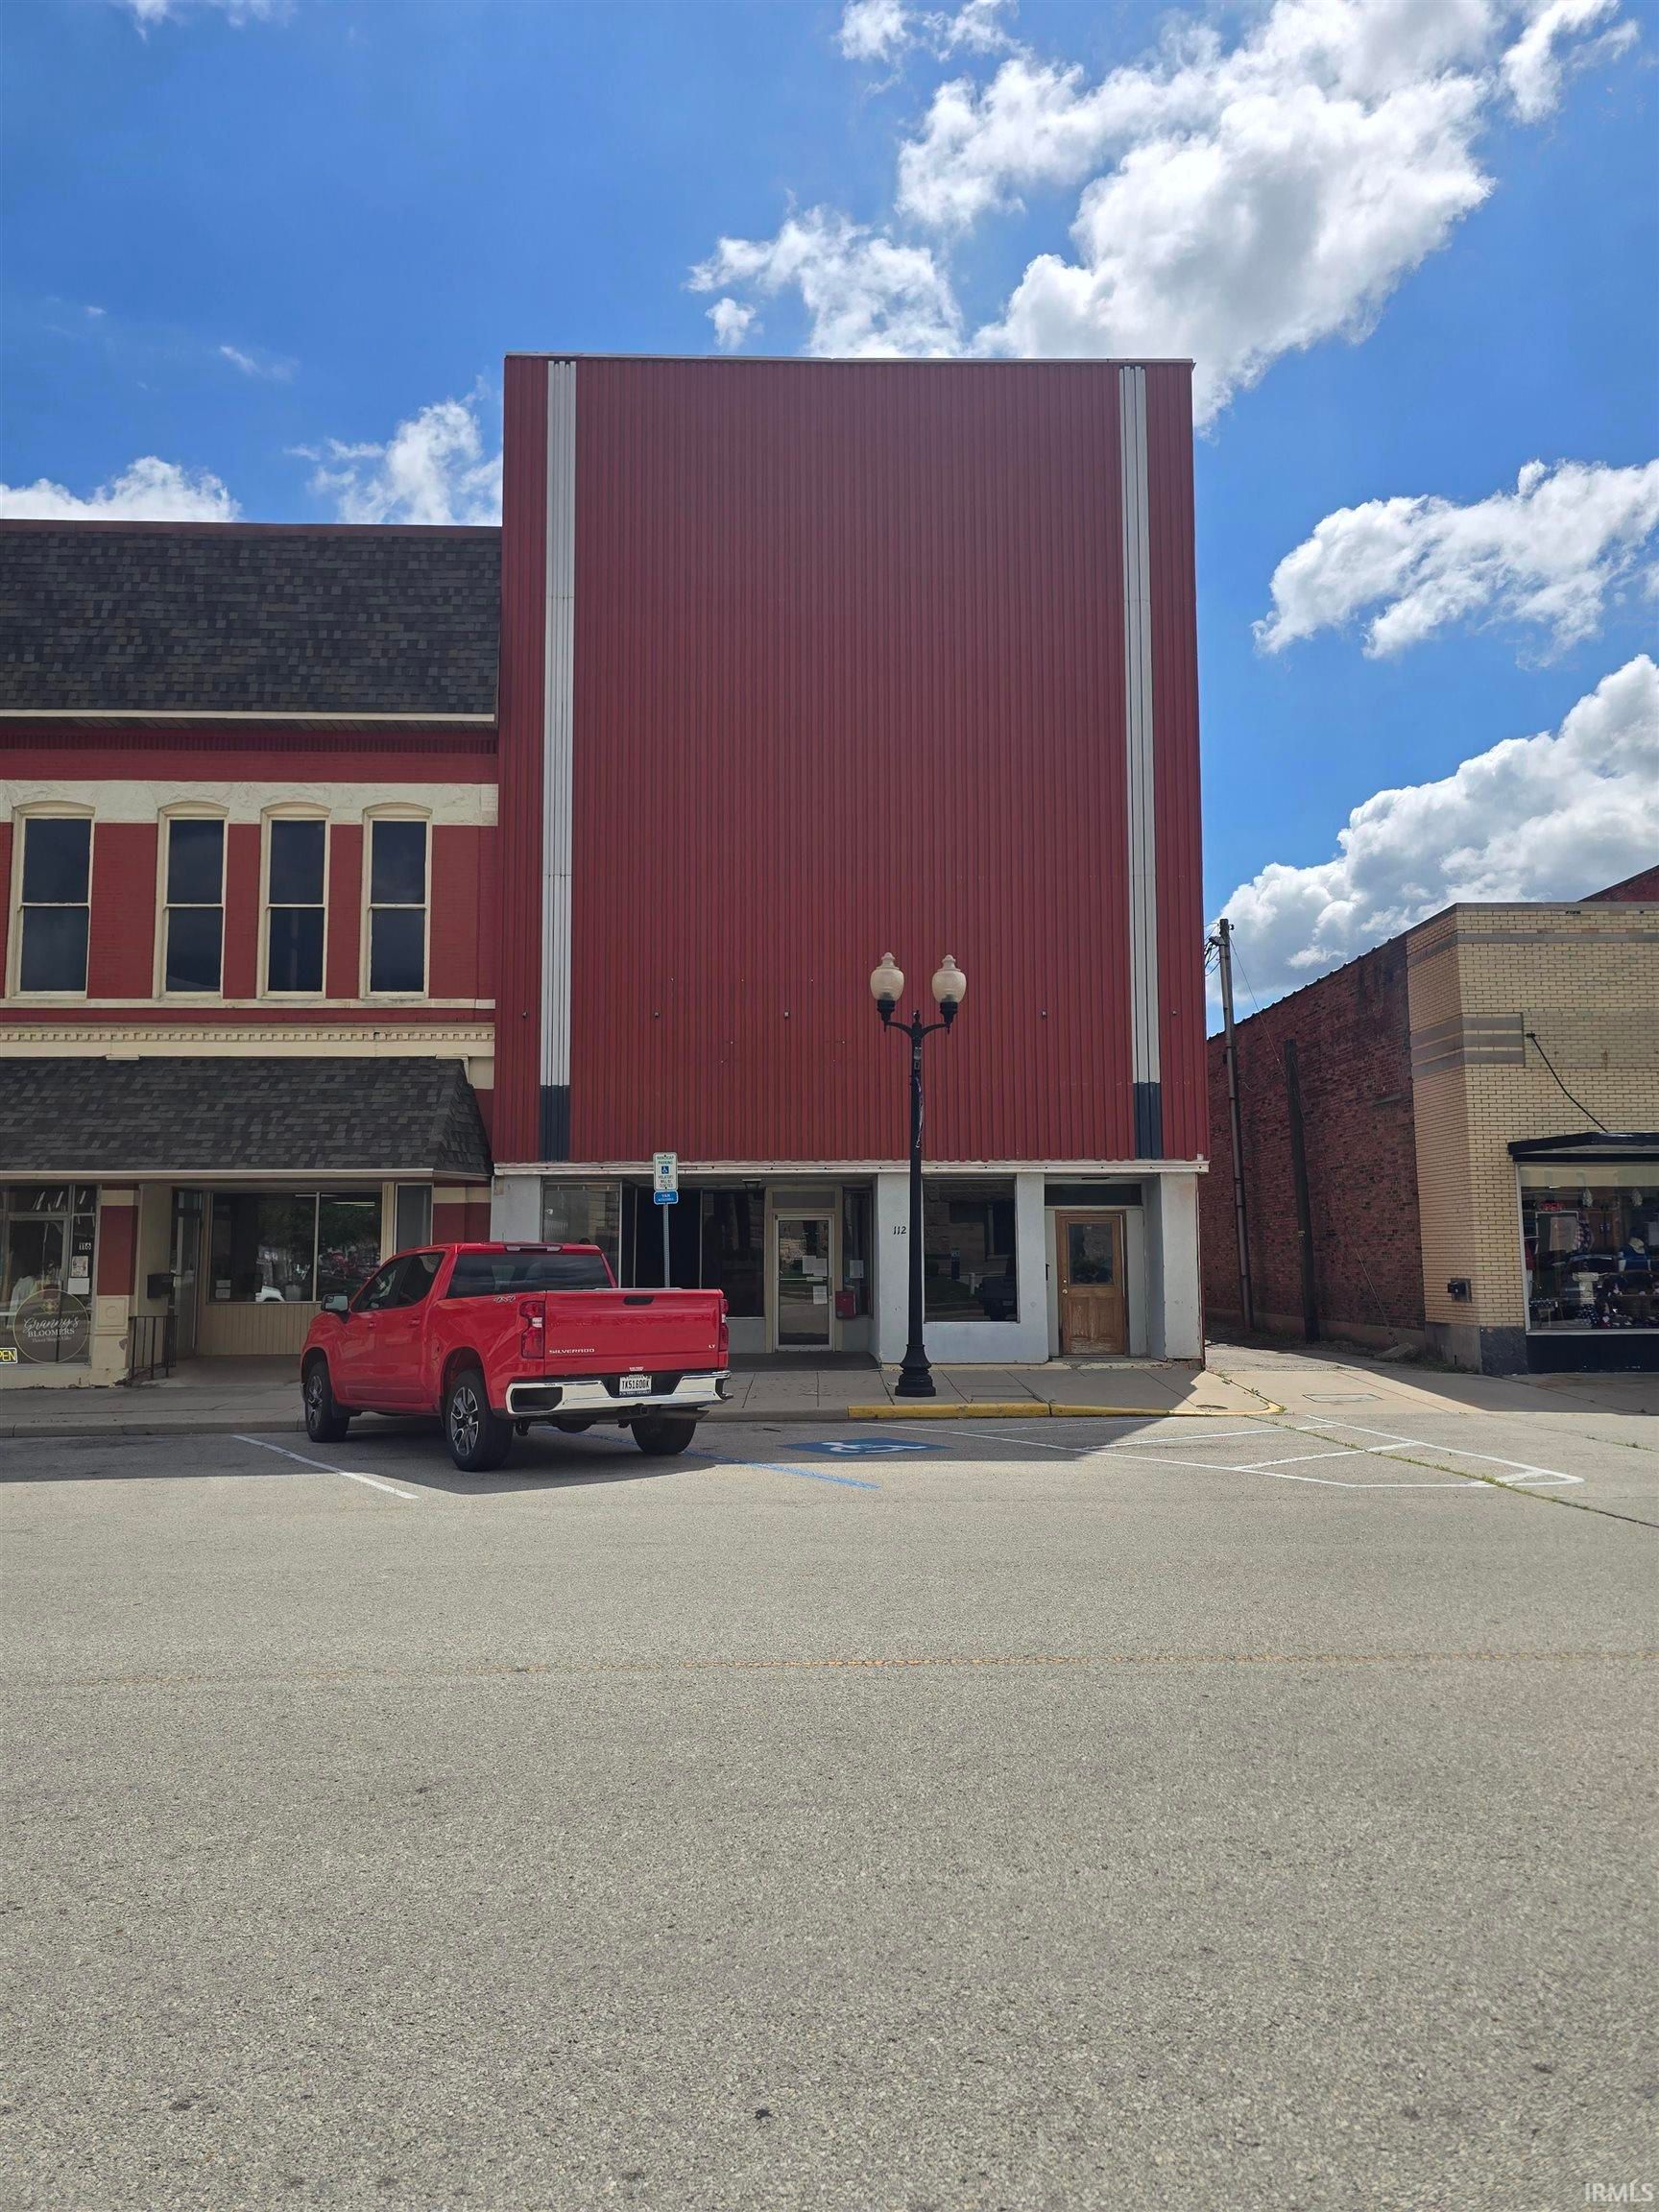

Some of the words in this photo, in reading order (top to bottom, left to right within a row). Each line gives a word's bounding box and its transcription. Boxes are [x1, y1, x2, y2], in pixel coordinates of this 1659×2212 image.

[893, 1225, 906, 1235] 112
[23, 1315, 80, 1334] Granny's
[28, 1329, 75, 1337] BLOOMERS
